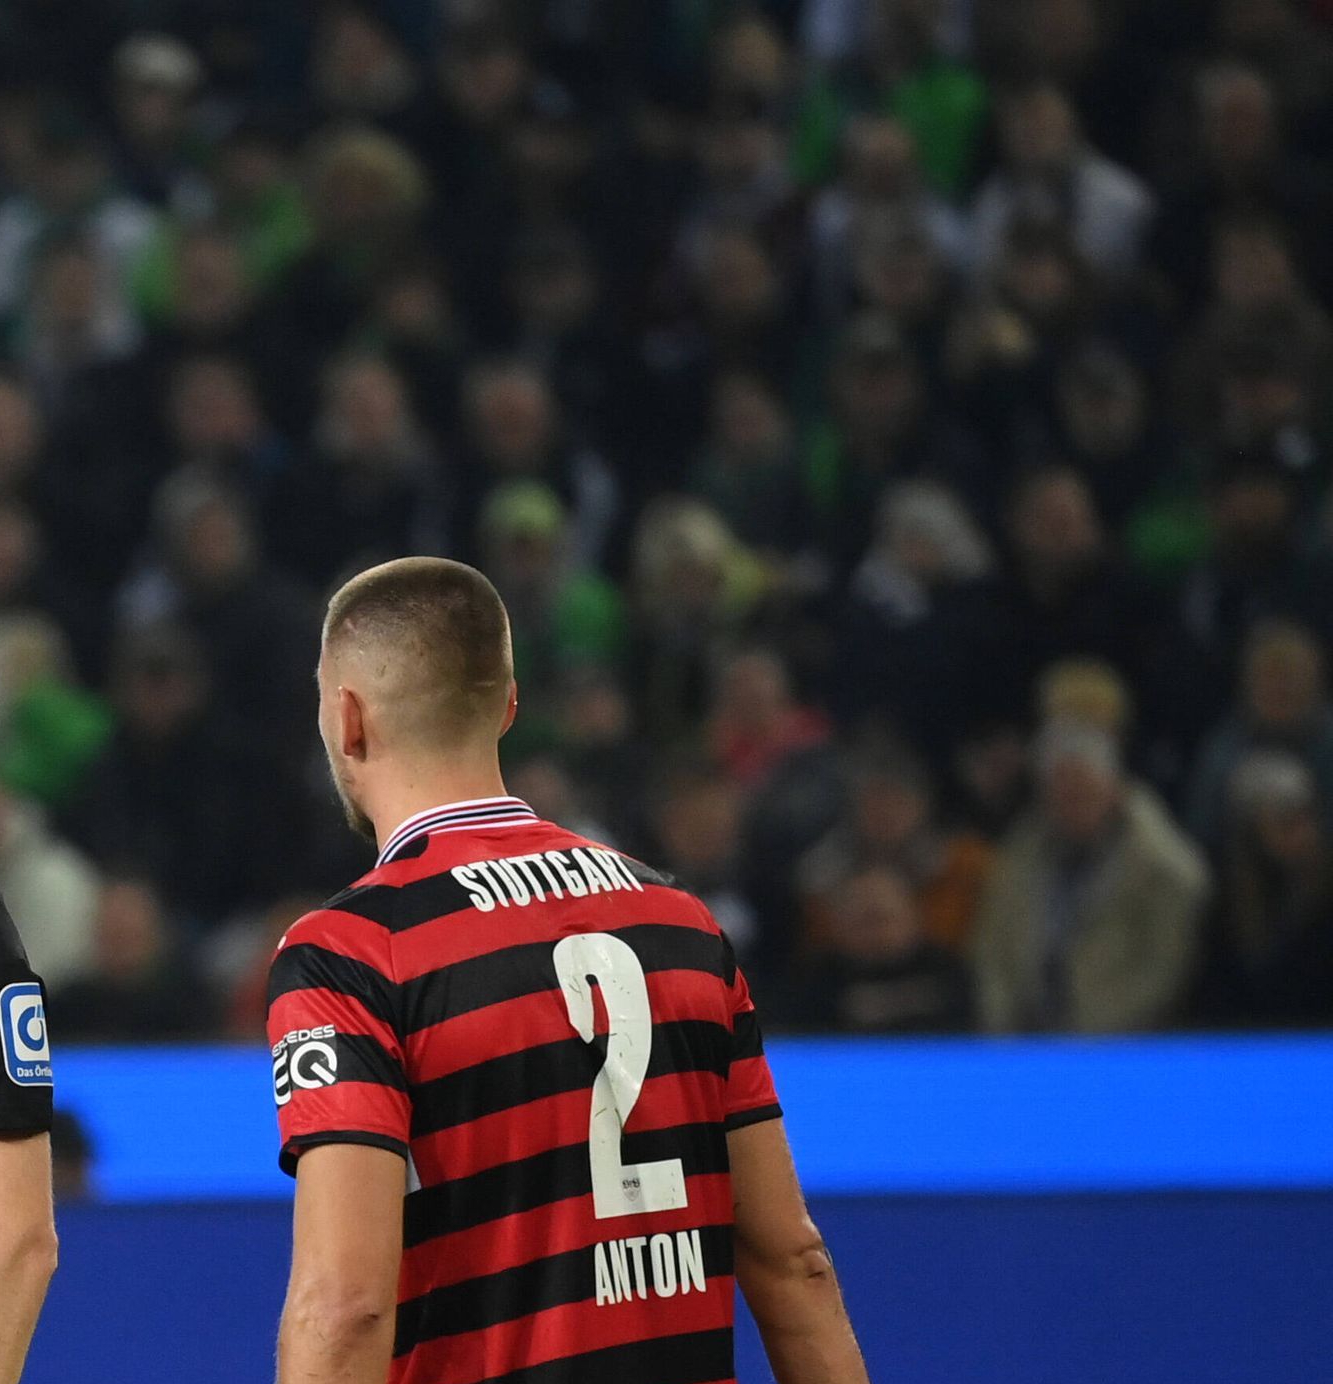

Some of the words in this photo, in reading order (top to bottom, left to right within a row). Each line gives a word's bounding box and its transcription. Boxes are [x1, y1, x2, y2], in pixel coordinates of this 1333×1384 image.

[451, 847, 644, 913] STUTTGART
[552, 932, 688, 1219] 2
[594, 1230, 707, 1306] ANTON
